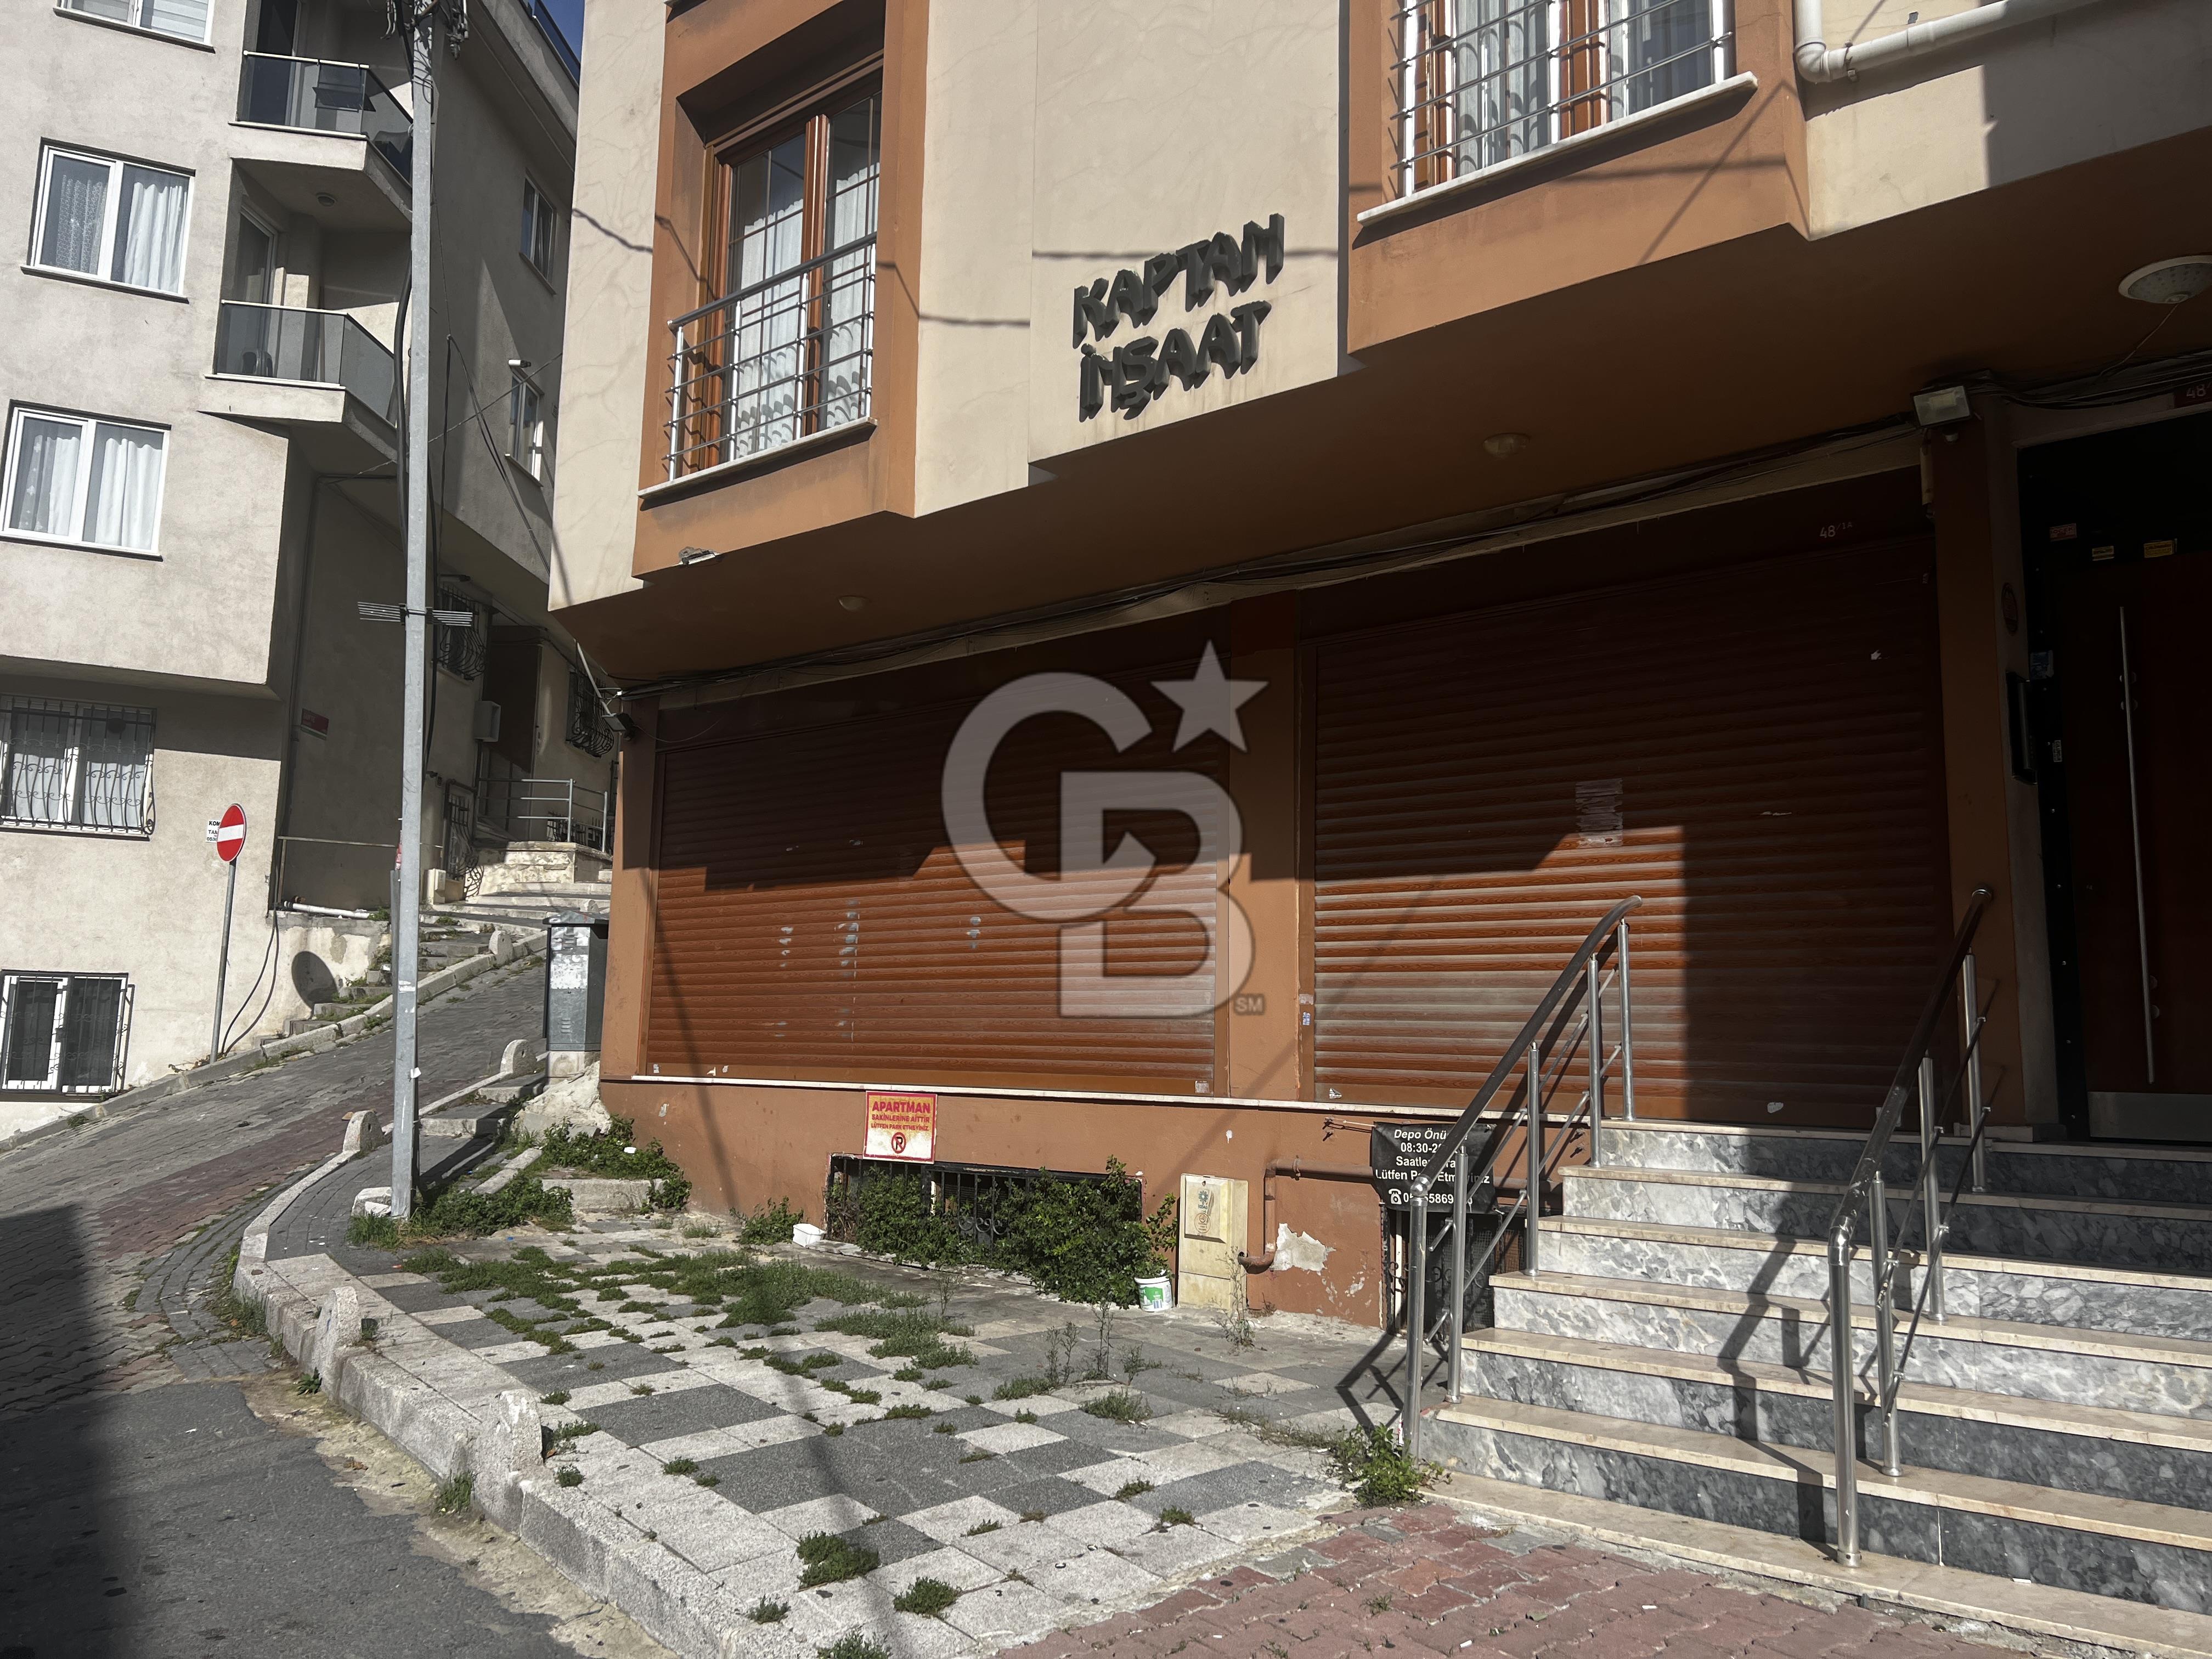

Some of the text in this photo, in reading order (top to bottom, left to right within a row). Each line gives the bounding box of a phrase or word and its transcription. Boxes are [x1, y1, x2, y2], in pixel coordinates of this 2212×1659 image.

[1073, 213, 1284, 349] KAPTAN
[1079, 300, 1272, 422] İNŞAAT
[872, 1101, 930, 1113] APARTMAN
[1394, 1129, 1421, 1141] Depo
[1396, 1156, 1431, 1167] Saatle
[1375, 1169, 1408, 1180] Lütfen
